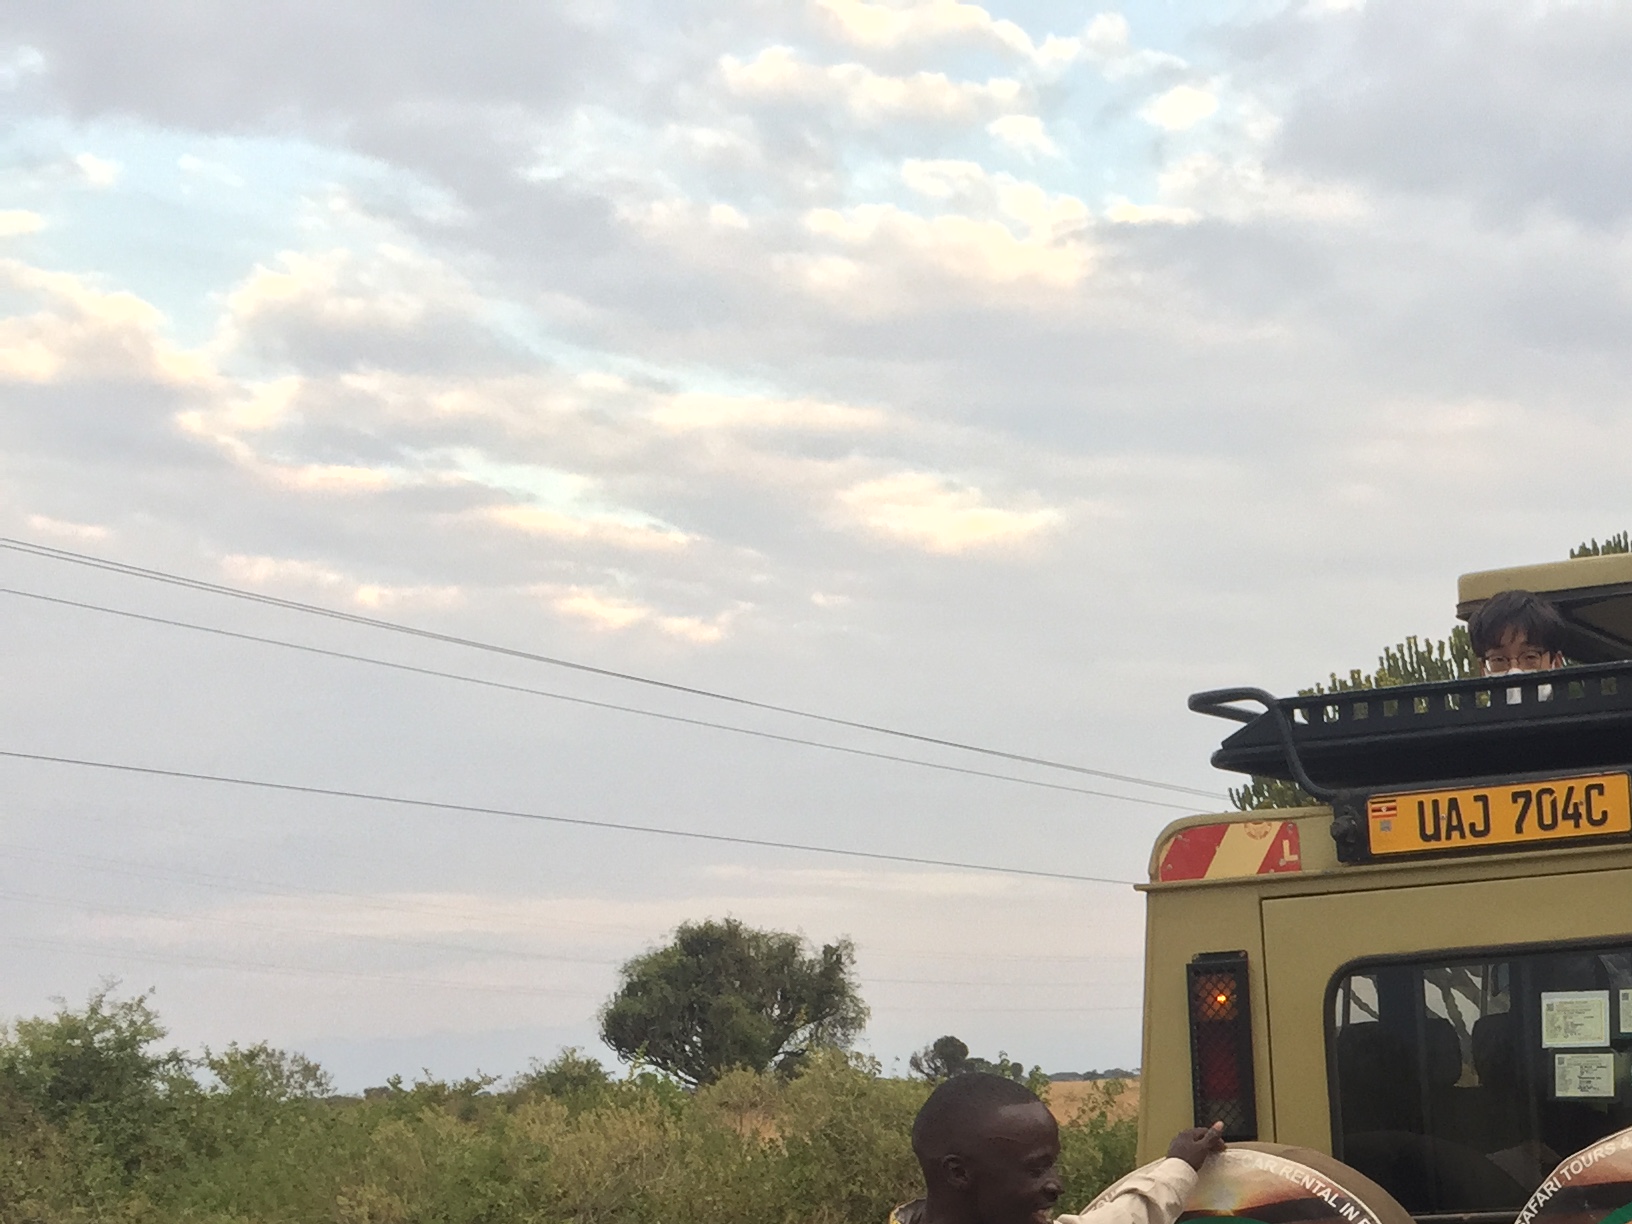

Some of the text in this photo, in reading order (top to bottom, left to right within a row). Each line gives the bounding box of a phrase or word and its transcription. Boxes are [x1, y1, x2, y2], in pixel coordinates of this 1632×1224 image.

[1417, 783, 1609, 843] UAJ 704C
[1282, 839, 1299, 862] L
[1559, 1142, 1617, 1181] TOURS
[1279, 1164, 1339, 1209] RENTAL
[1339, 1202, 1360, 1221] IN
